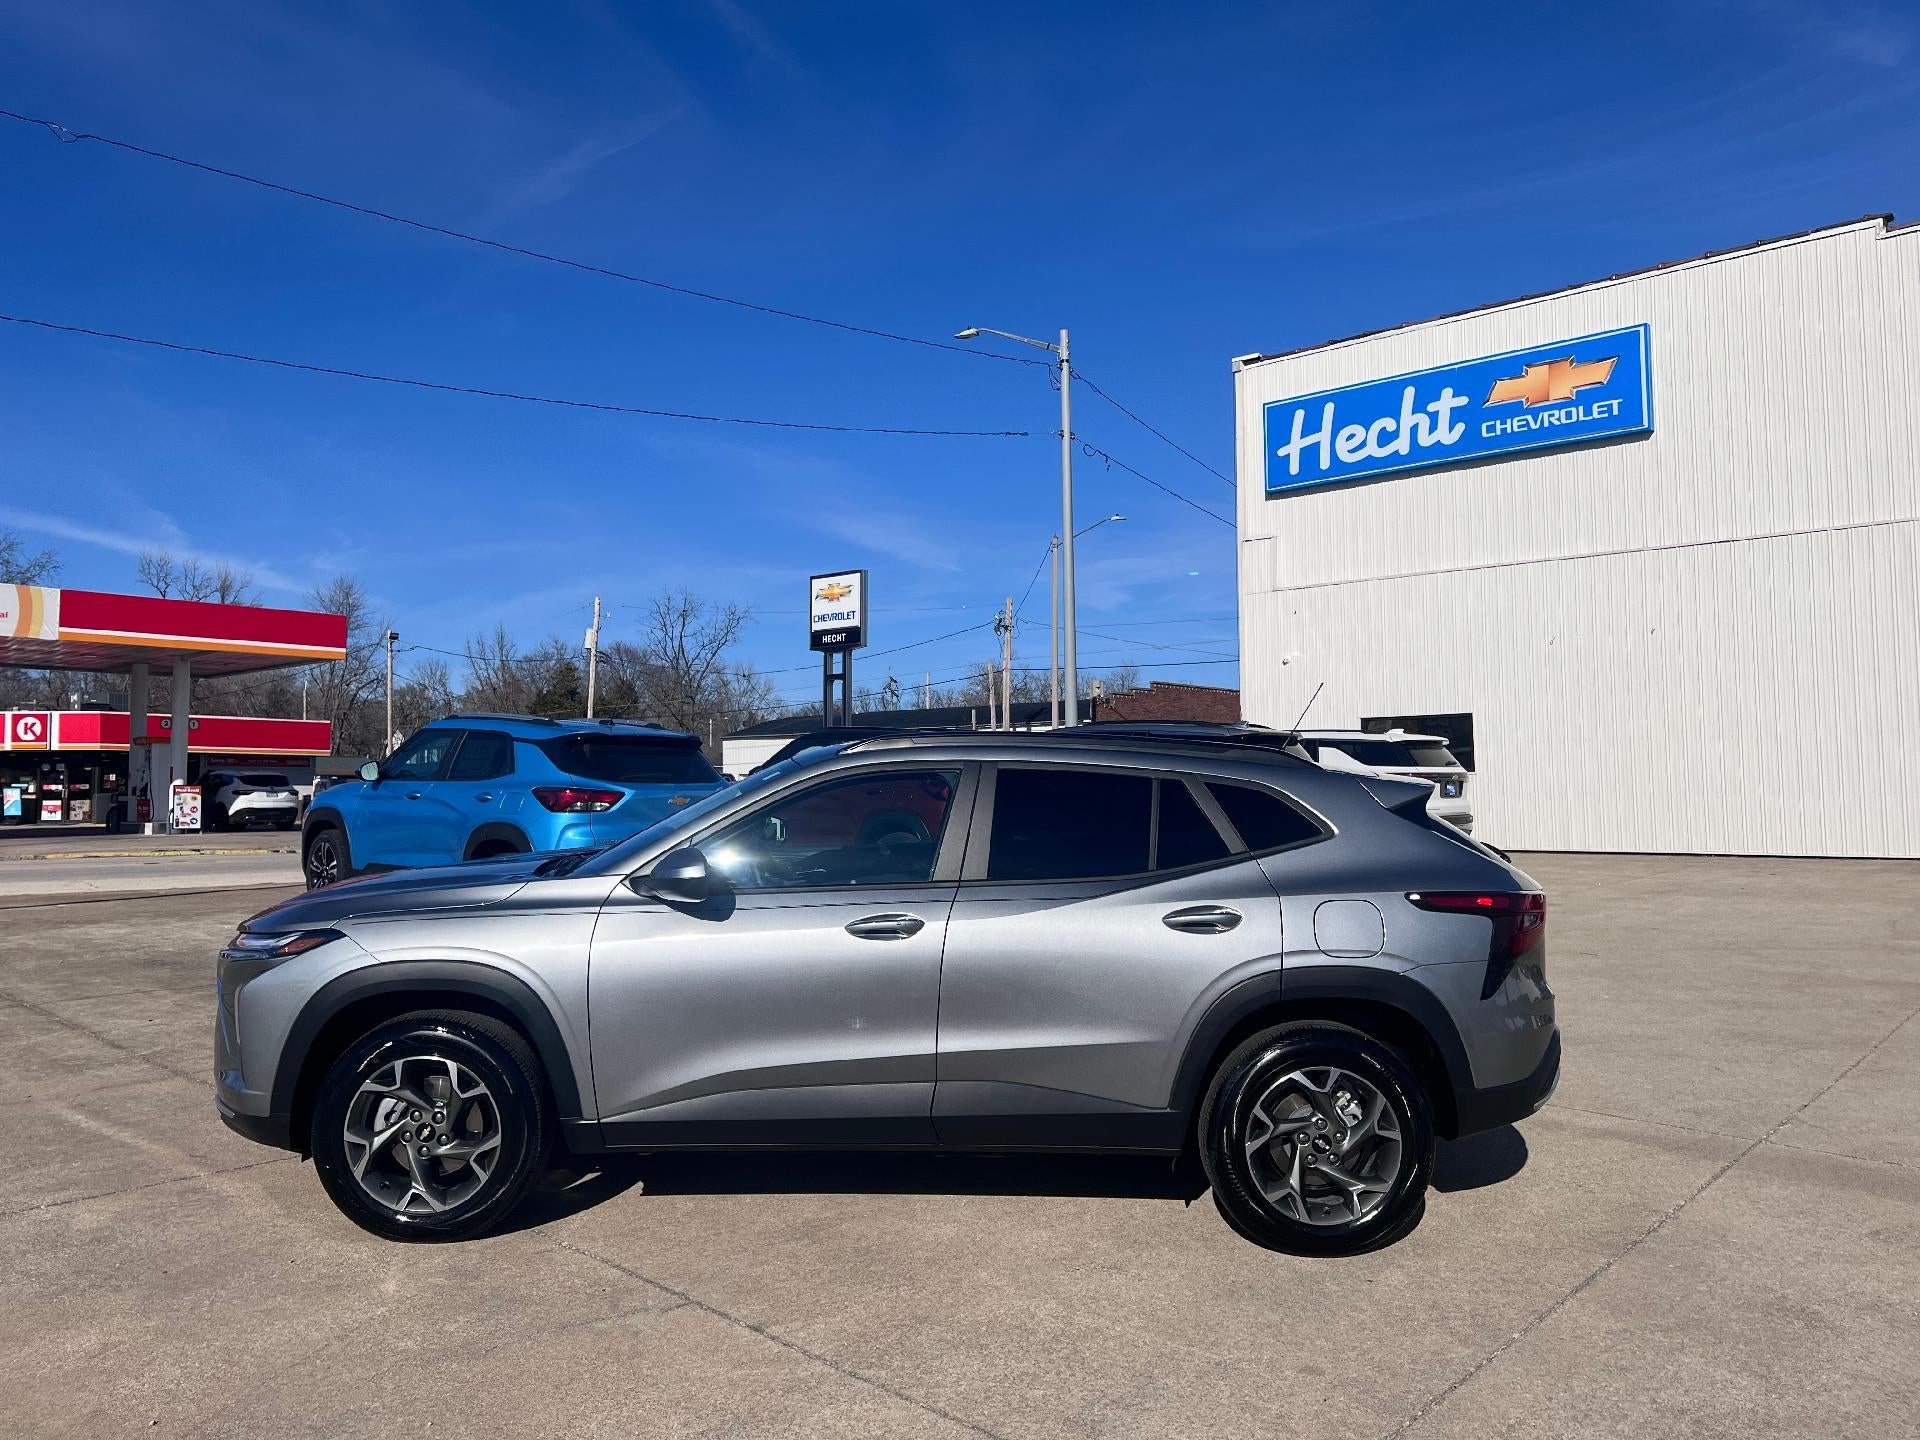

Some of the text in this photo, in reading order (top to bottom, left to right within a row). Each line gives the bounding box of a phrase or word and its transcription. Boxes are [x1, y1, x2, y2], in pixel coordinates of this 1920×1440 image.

[1277, 386, 1623, 475] Hecht CHEVROLET
[813, 610, 856, 623] CHEVROLET
[822, 633, 847, 643] HECHT
[24, 722, 38, 738] K
